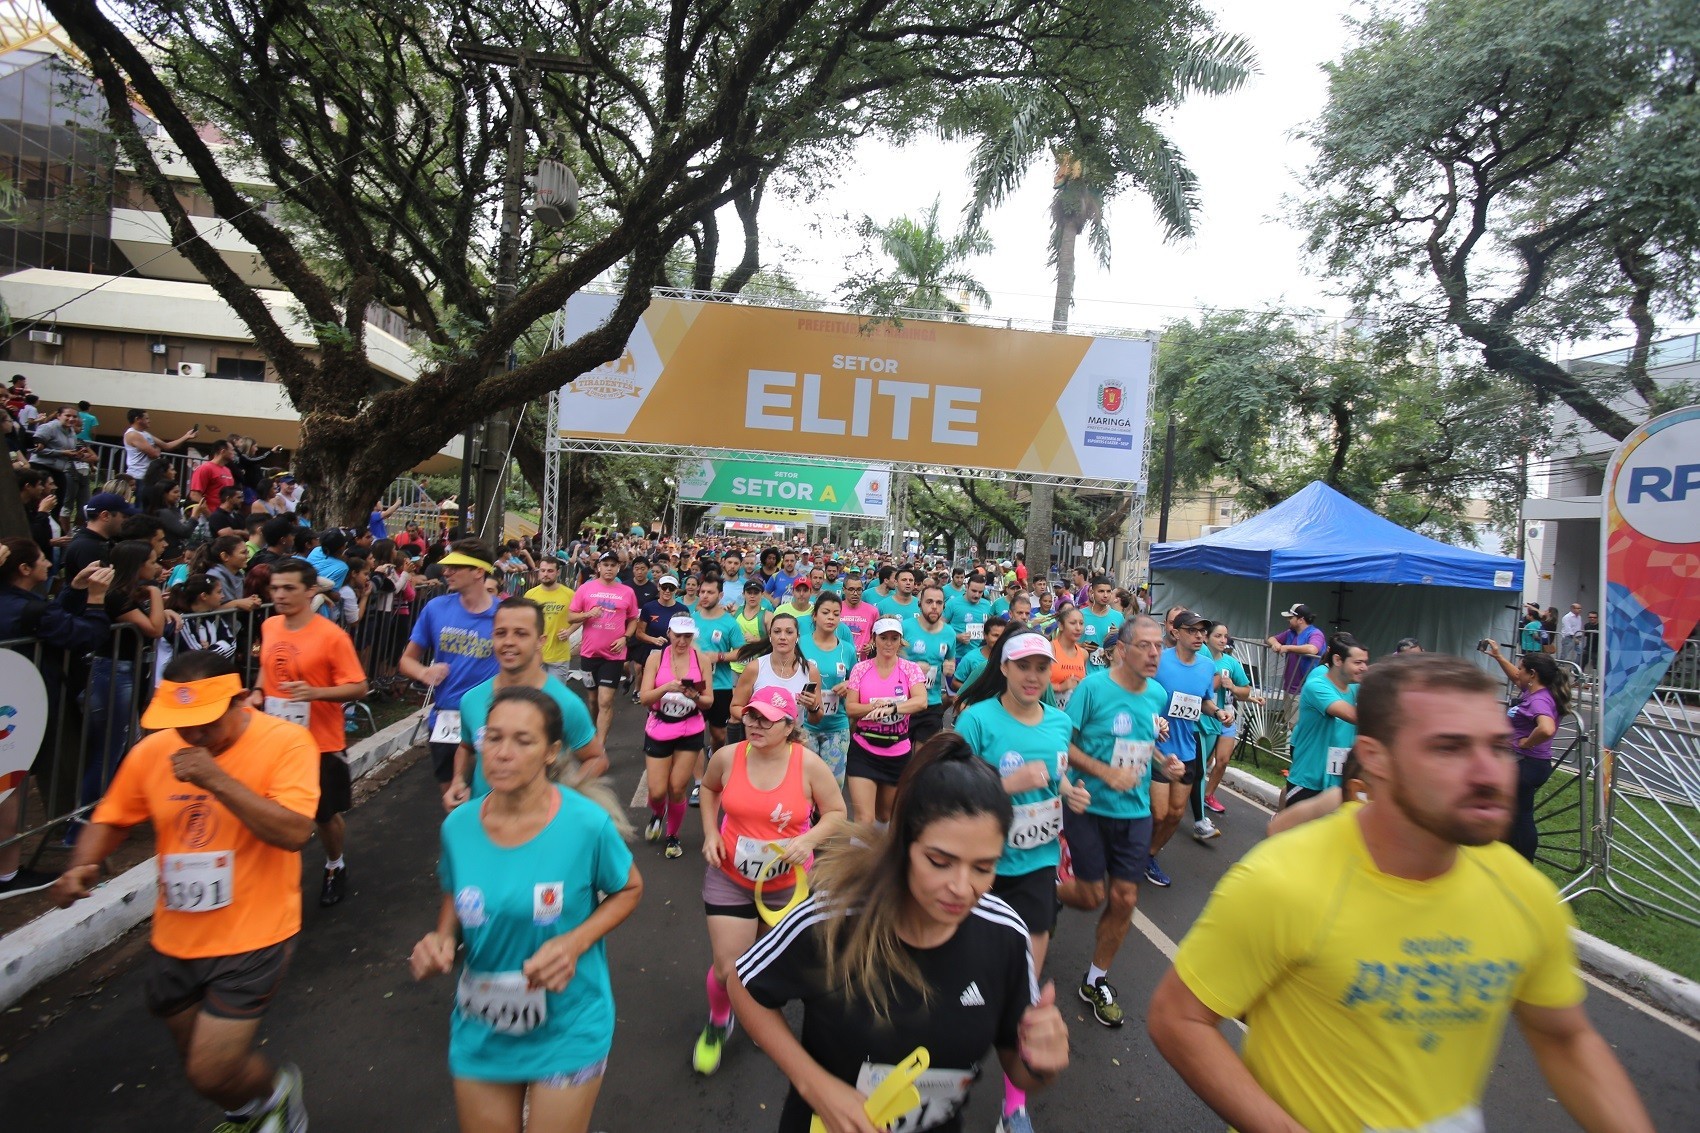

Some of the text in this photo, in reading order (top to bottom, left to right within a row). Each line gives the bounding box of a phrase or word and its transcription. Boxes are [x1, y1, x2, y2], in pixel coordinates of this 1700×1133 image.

[798, 318, 865, 337] PREFEITUR
[832, 354, 898, 374] SETOR
[579, 379, 633, 390] TIRADENTES
[745, 369, 981, 446] ELITE
[1088, 416, 1131, 427] MARINGÁ
[774, 470, 798, 479] SETOR
[731, 477, 837, 503] SETOR A
[1171, 704, 1199, 719] 2829
[738, 859, 790, 879] 4760
